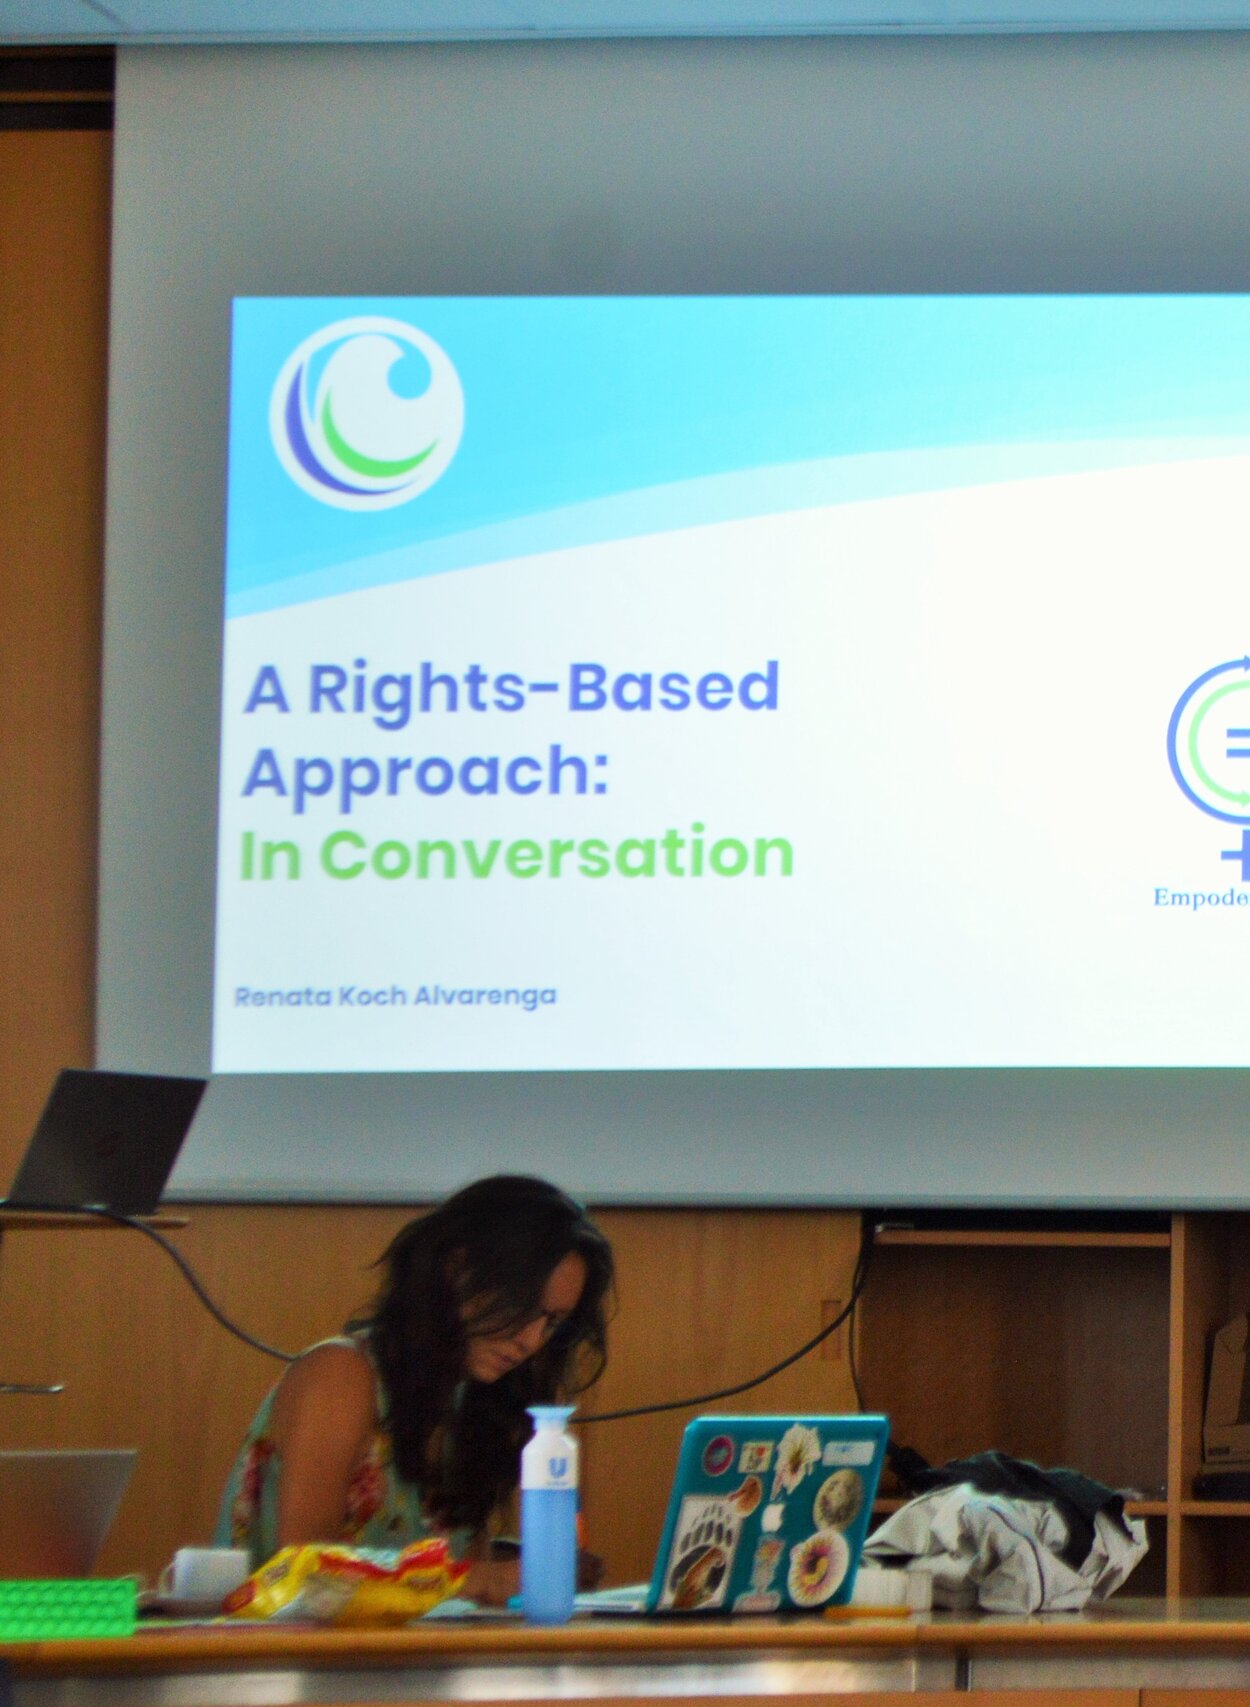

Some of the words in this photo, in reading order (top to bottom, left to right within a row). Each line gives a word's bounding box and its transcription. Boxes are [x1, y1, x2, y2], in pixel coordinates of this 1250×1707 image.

[243, 664, 291, 713] A
[309, 656, 779, 732] Rights-Based
[241, 743, 609, 815] Approach:
[240, 831, 301, 881] In
[319, 821, 794, 881] Conversation
[235, 986, 332, 1007] Renata
[338, 985, 408, 1006] Koch
[413, 984, 558, 1012] Alvarenga
